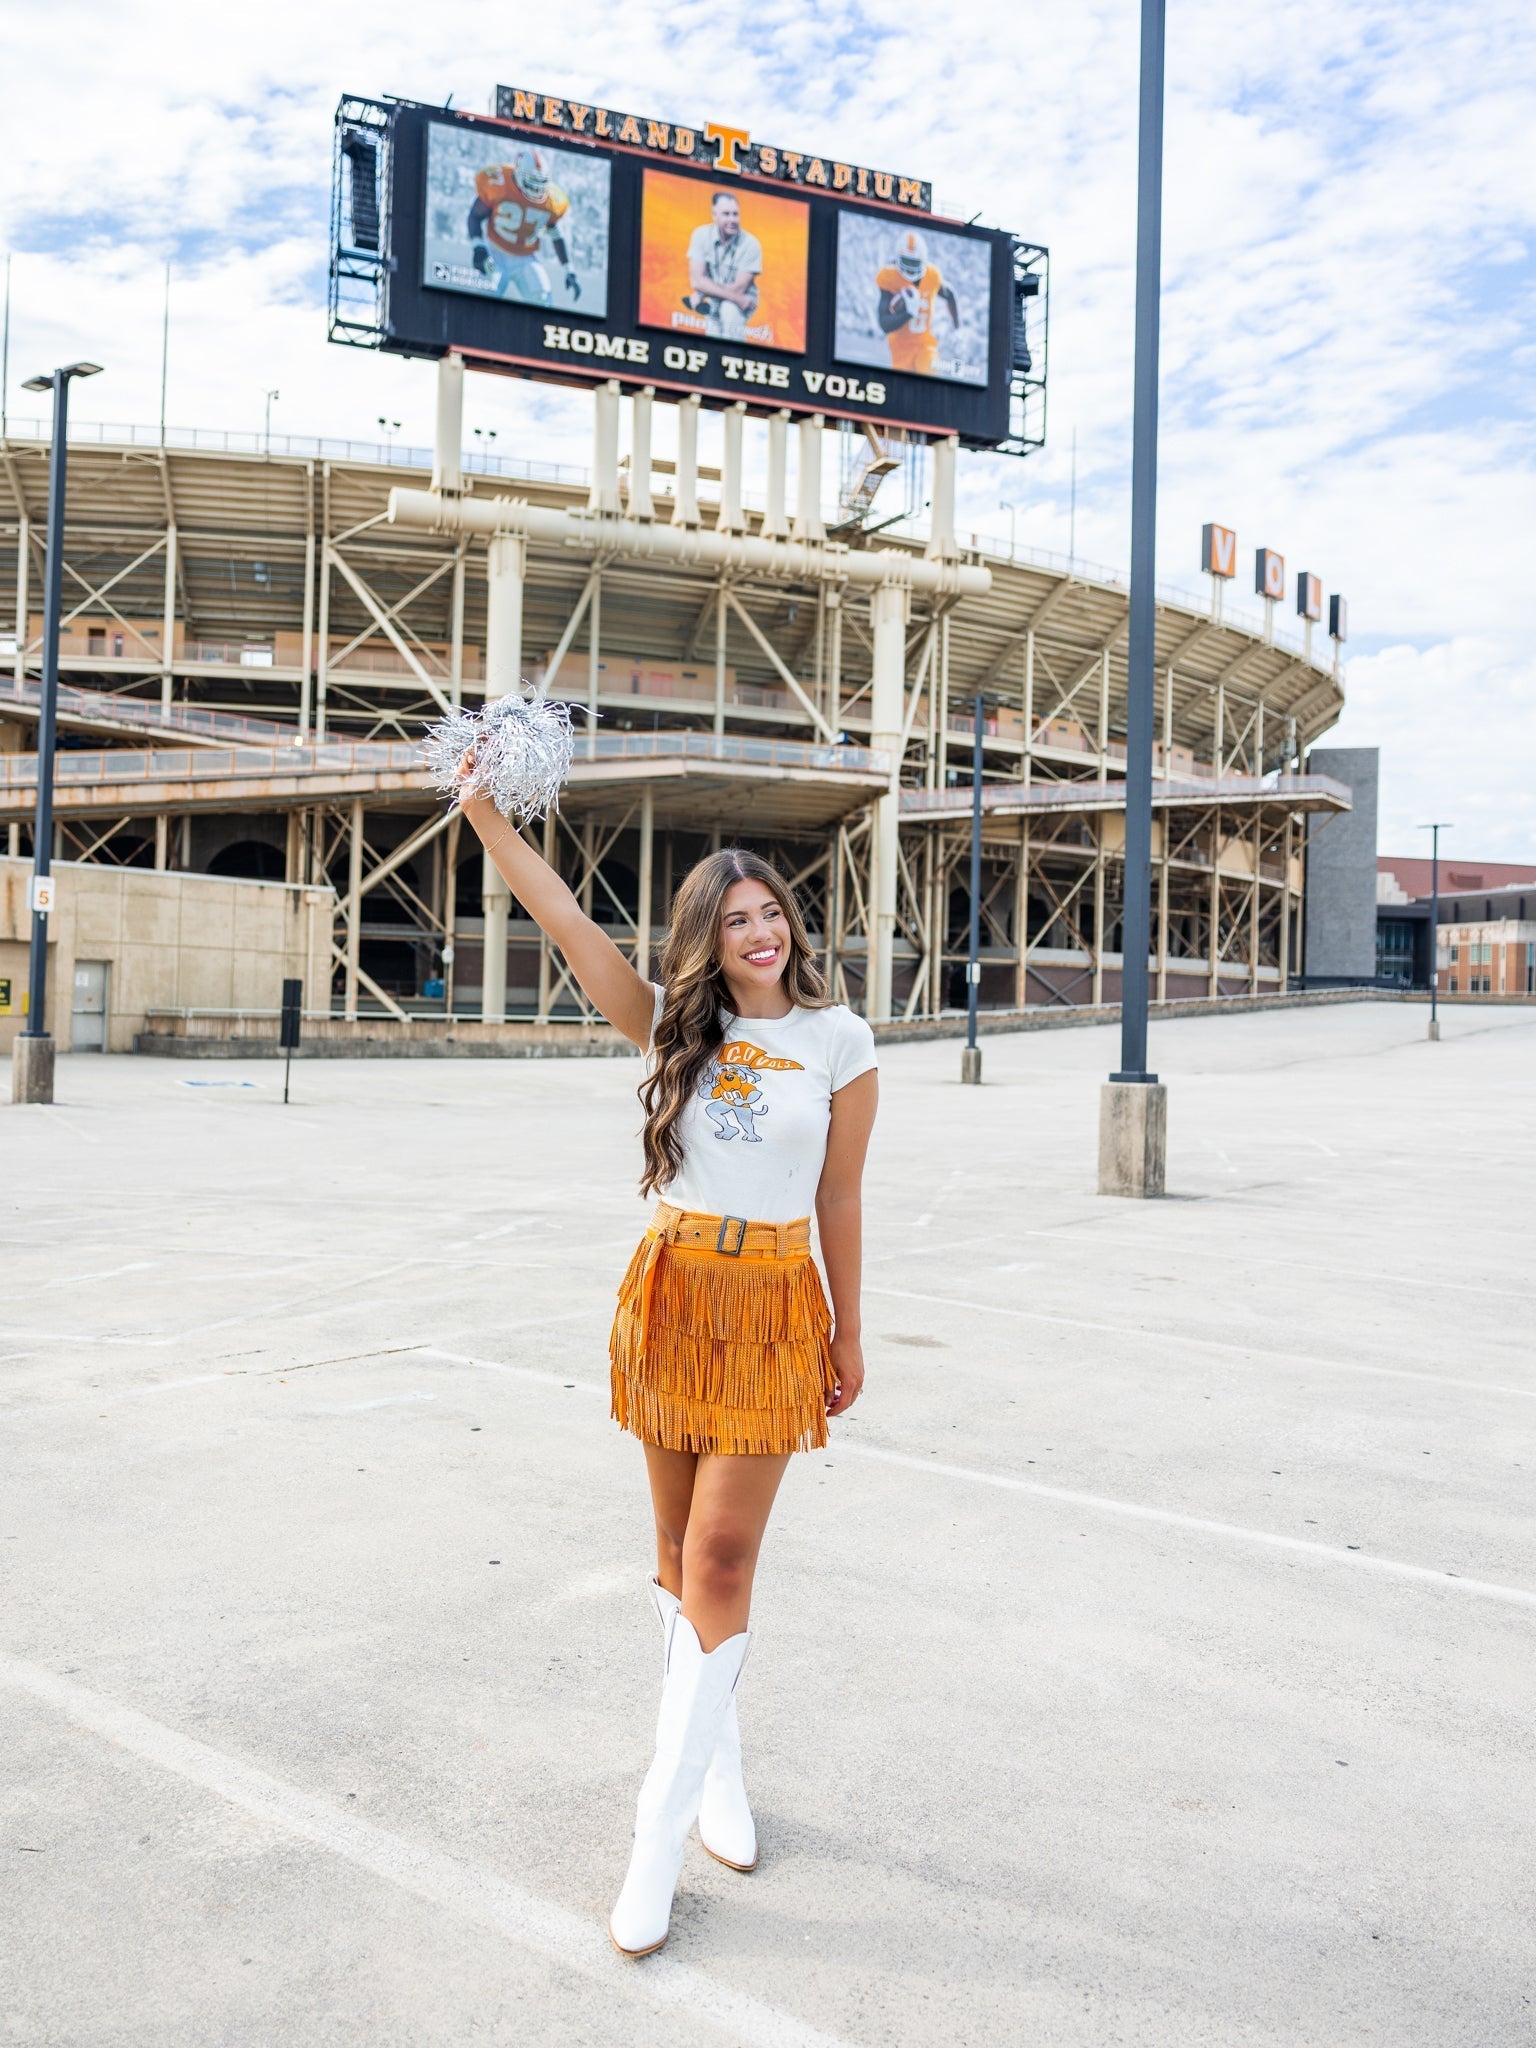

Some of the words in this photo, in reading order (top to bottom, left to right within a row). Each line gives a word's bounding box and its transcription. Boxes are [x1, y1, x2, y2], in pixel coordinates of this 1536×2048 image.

[512, 90, 695, 155] NEYLAND
[704, 121, 750, 175] T
[759, 146, 922, 205] STADIUM
[493, 200, 551, 248] 27
[543, 324, 650, 364] HOME
[663, 345, 709, 373] OF
[721, 355, 790, 388] THE
[802, 370, 886, 405] VOLS
[39, 891, 49, 905] 5
[727, 1045, 756, 1063] GO
